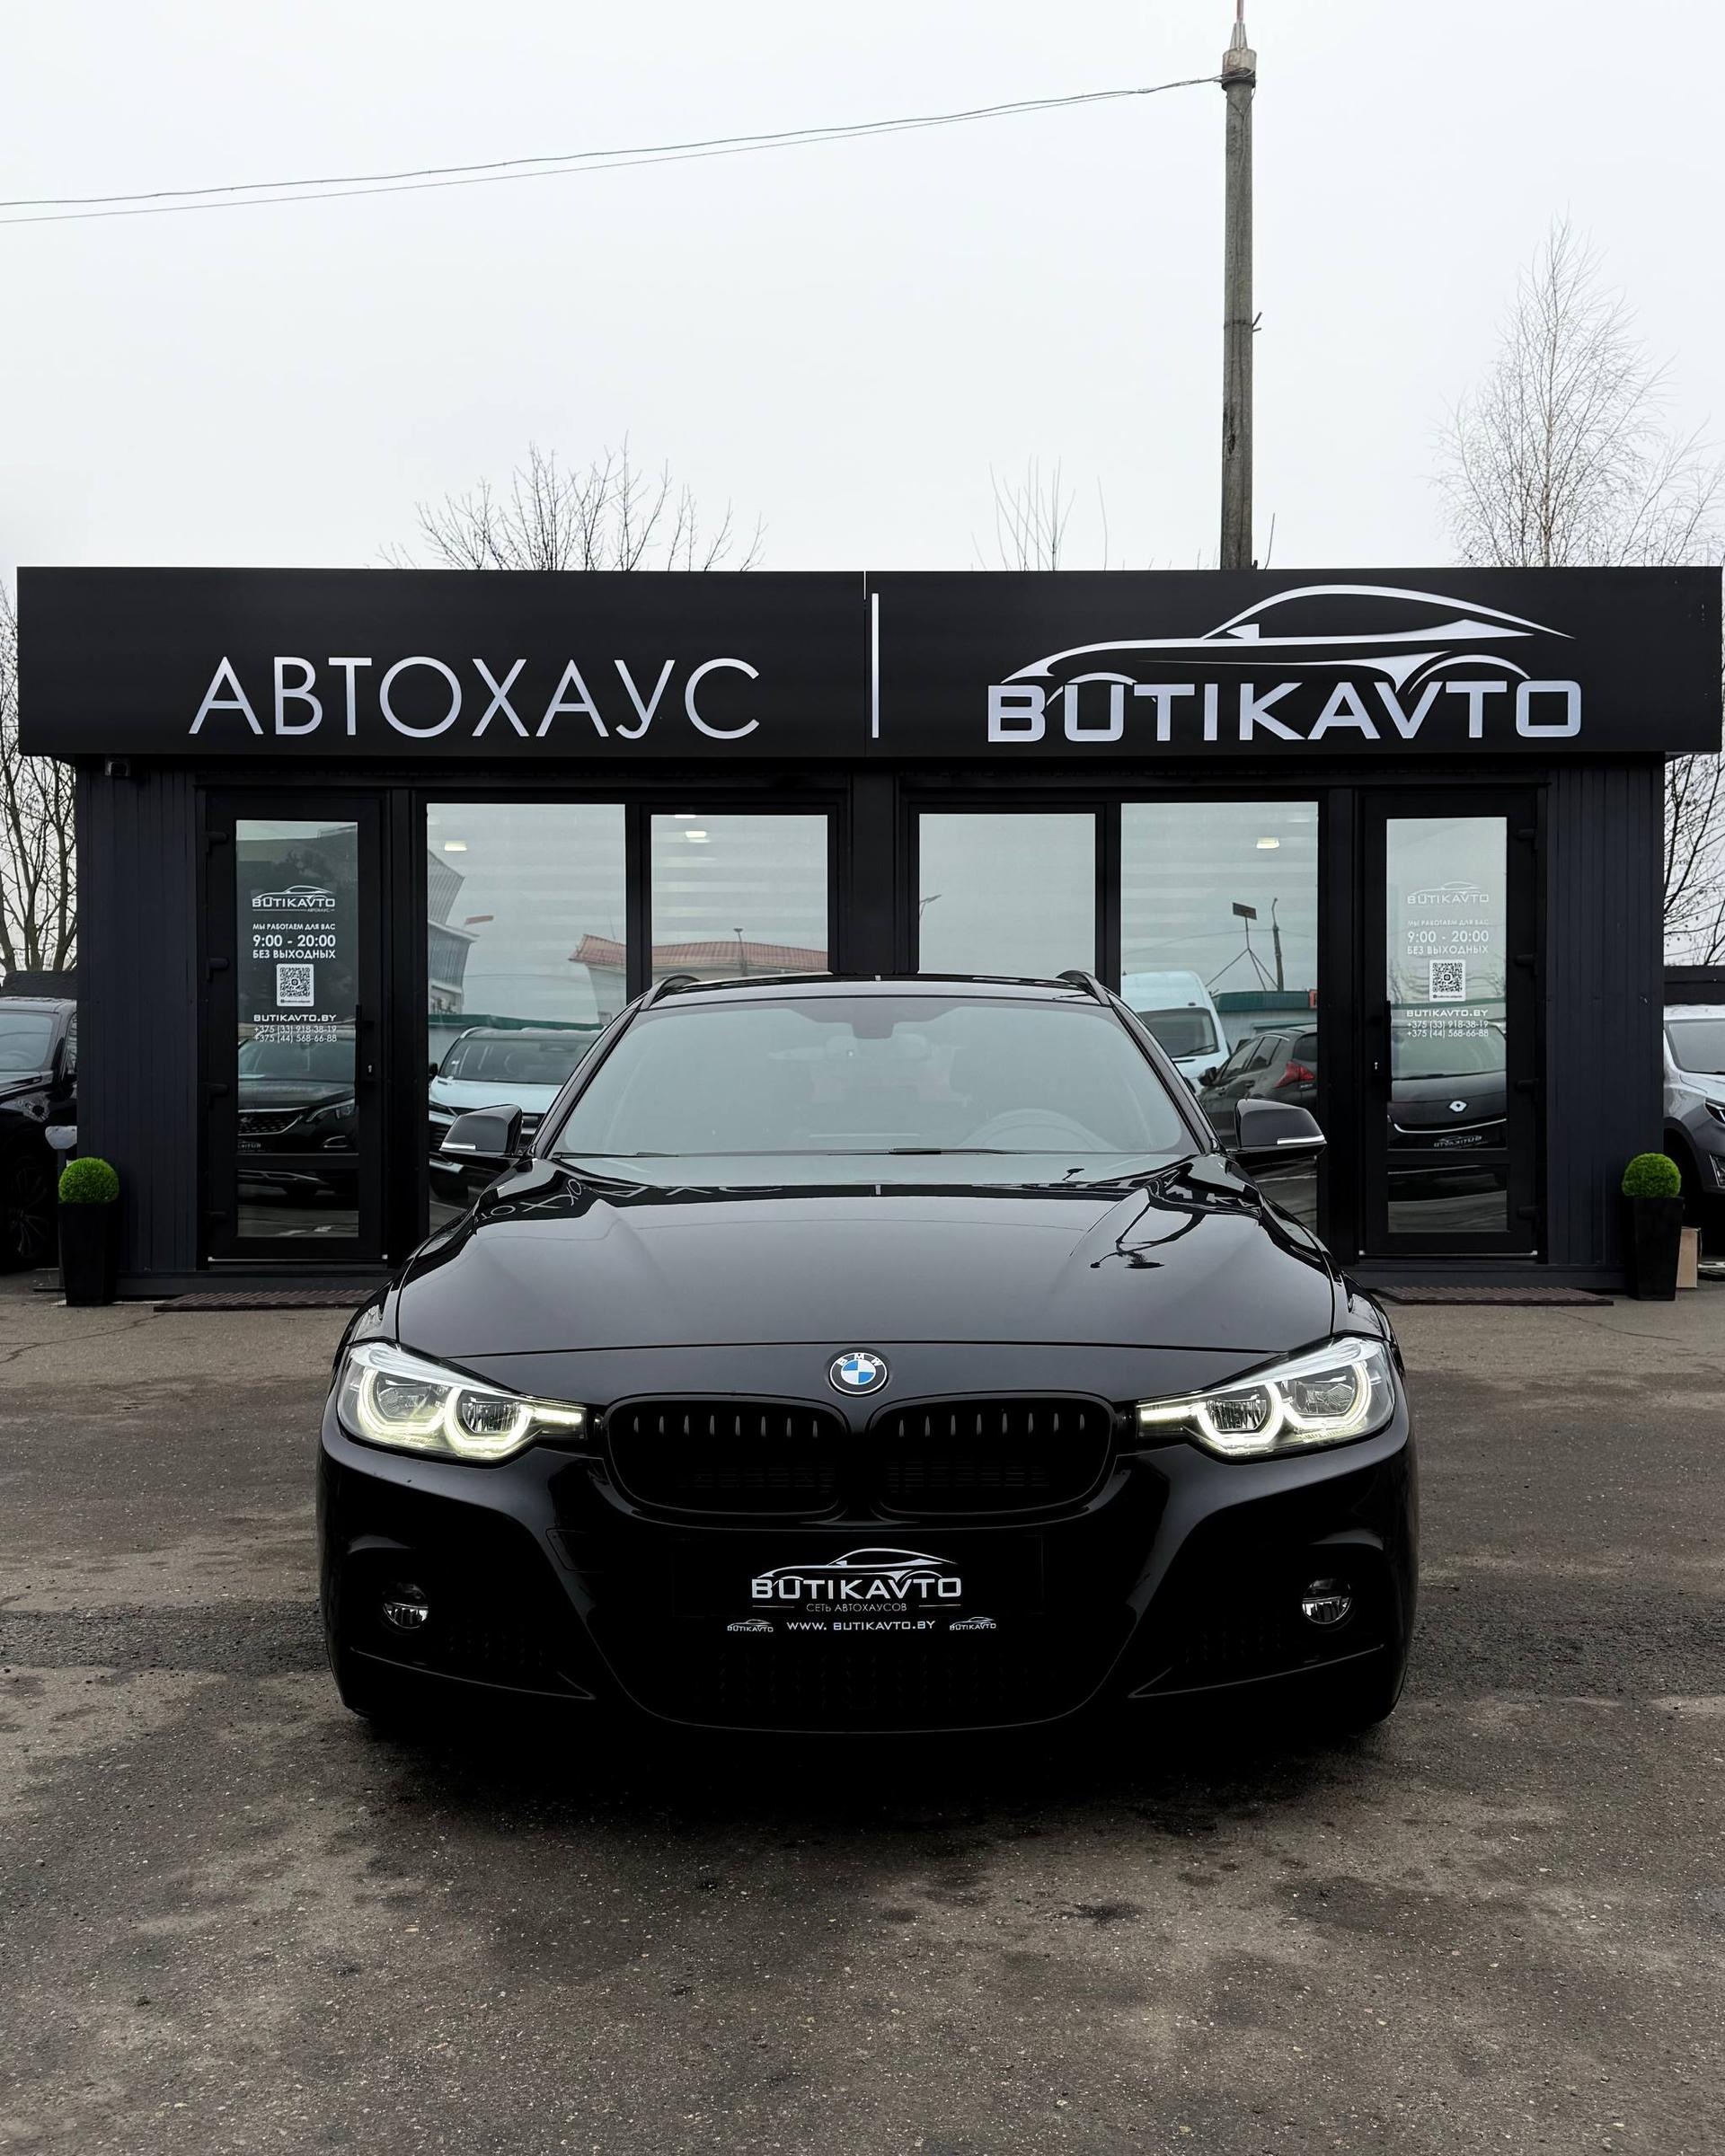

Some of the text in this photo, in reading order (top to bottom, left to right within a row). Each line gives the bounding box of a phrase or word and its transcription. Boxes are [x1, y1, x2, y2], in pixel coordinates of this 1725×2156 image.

[189, 656, 760, 740] АВТОХАУС
[987, 679, 1582, 743] BUTIKAVTO
[252, 898, 335, 907] BUTIKAVTO
[1407, 894, 1489, 905] BUTIKAVTO
[252, 934, 283, 947] 9:00
[297, 934, 336, 947] 20:00
[1408, 931, 1437, 943] 9:00
[1451, 930, 1489, 942] 20:00
[252, 950, 336, 959] БЕЗ ВЫХОДНЫХ
[1407, 945, 1489, 955] БЕЗ ВЫХОДНЫХ
[253, 1014, 337, 1022] BUTIKAVTO.BY
[1406, 1009, 1489, 1017] BUTIKAVTO.BY
[254, 1025, 337, 1035] +375 (33) 918-38-19
[1407, 1020, 1489, 1030] +375 (33) 918-38-19
[1407, 1029, 1489, 1038] +375 (44) 568-66-88
[277, 1034, 294, 1044] (44)
[296, 1034, 337, 1042] 568-66-88
[836, 1353, 883, 1366] BMW
[751, 1577, 961, 1599] BUTIKAVTO
[806, 1602, 907, 1613] СЕТЬ АВТОХАУСОВ
[727, 1625, 774, 1633] BUTIKAVTO
[833, 1621, 935, 1630] BUTIKAVTO.BY
[949, 1622, 996, 1631] BUTIKAVTO
